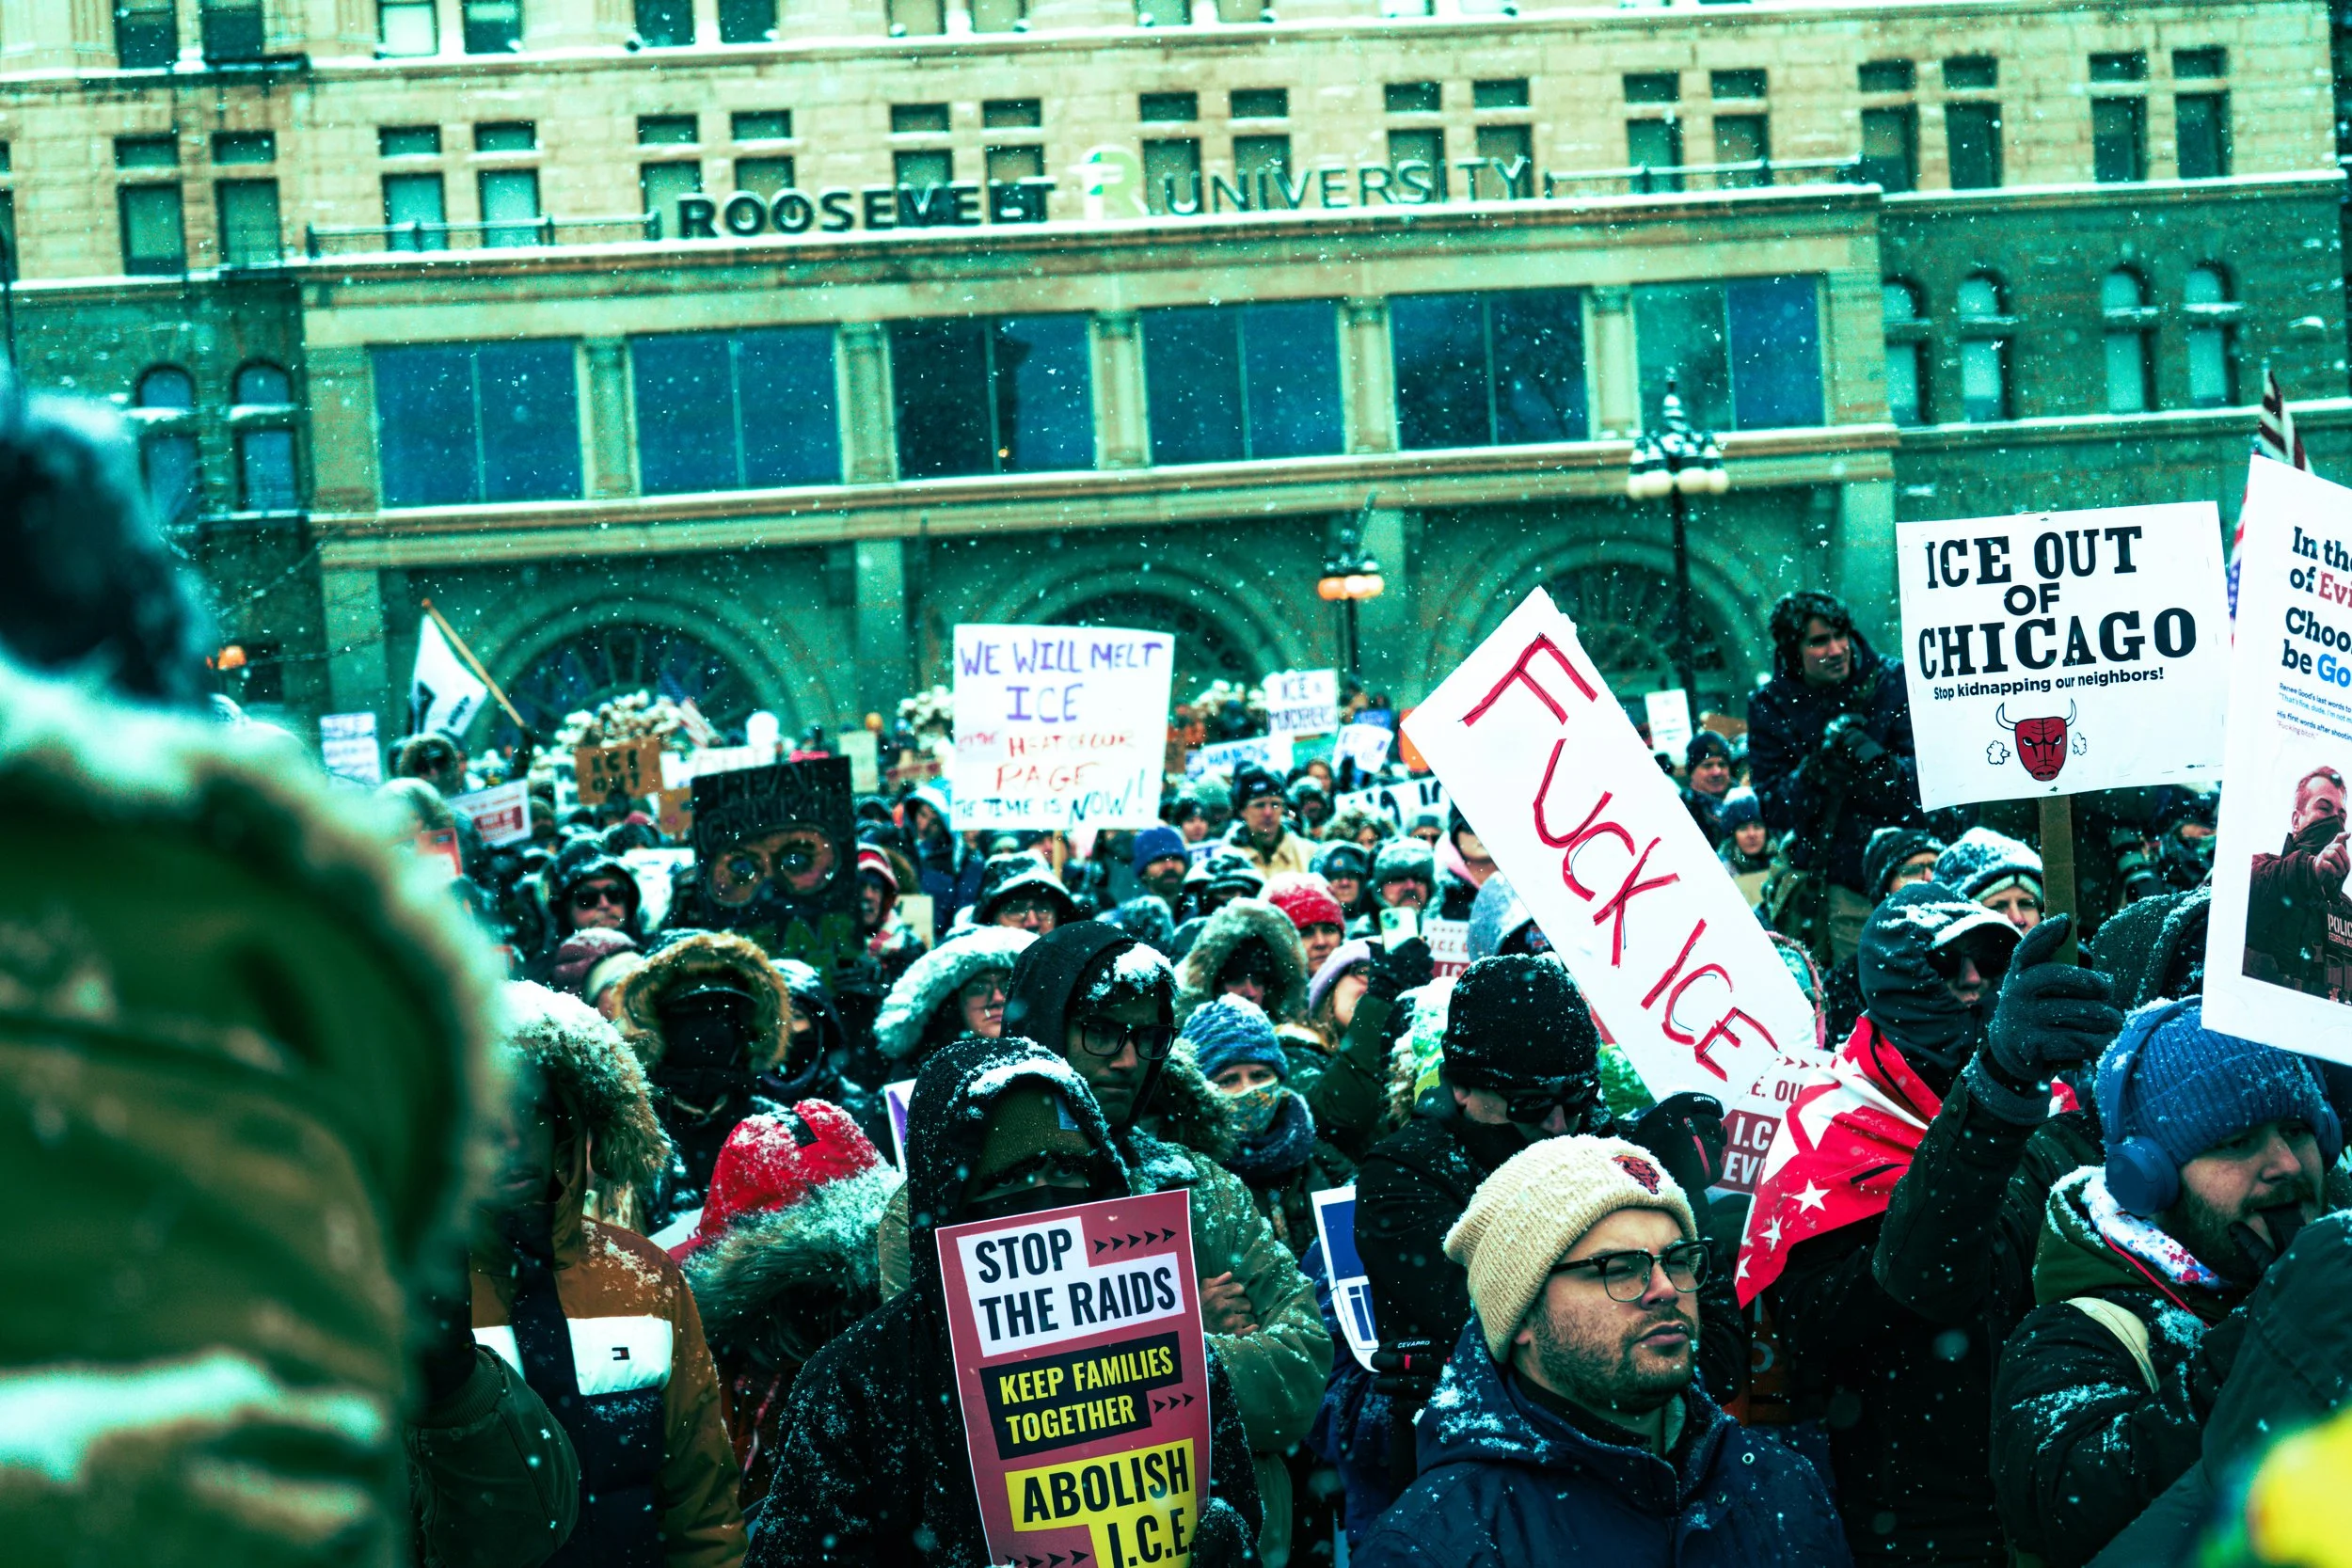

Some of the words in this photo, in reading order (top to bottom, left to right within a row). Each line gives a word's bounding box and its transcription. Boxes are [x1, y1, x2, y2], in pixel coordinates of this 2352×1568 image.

[677, 176, 1057, 239] ROOSEVELT
[1163, 155, 1530, 216] UNIVERSITY
[1925, 535, 2011, 589] ICE
[2034, 525, 2142, 580] OUT
[2293, 525, 2318, 561] In
[2324, 539, 2352, 572] th
[2003, 582, 2060, 616] OF
[2290, 565, 2316, 594] of
[1918, 608, 2197, 679] CHICAGO
[2285, 607, 2352, 655] Choo
[960, 640, 1001, 676] WE
[1013, 638, 1082, 673] WILL
[1090, 641, 1164, 670] MELT
[2281, 639, 2312, 674] be
[2317, 654, 2351, 688] Go
[1006, 683, 1084, 723] ICE
[1934, 687, 1955, 701] Stop
[1957, 677, 2051, 697] kidnapping
[2056, 674, 2074, 689] our
[2077, 667, 2164, 688] neighbors!
[2316, 695, 2327, 705] last
[2328, 702, 2344, 711] words
[2345, 705, 2352, 713] to
[2299, 719, 2316, 729] words
[2317, 723, 2330, 733] after
[2331, 728, 2352, 742] shootin
[983, 798, 1032, 818] TIME
[1069, 768, 1145, 826] NOW!
[1457, 631, 1680, 968] FUCK
[1641, 919, 1780, 1082] ICE
[976, 1227, 1073, 1284] STOP
[979, 1287, 1059, 1341] THE
[1068, 1267, 1176, 1326] RAIDS
[999, 1367, 1064, 1405] KEEP
[1072, 1346, 1173, 1392] FAMILIES
[1006, 1395, 1136, 1445] TOGETHER
[1023, 1447, 1189, 1523] ABOLISH
